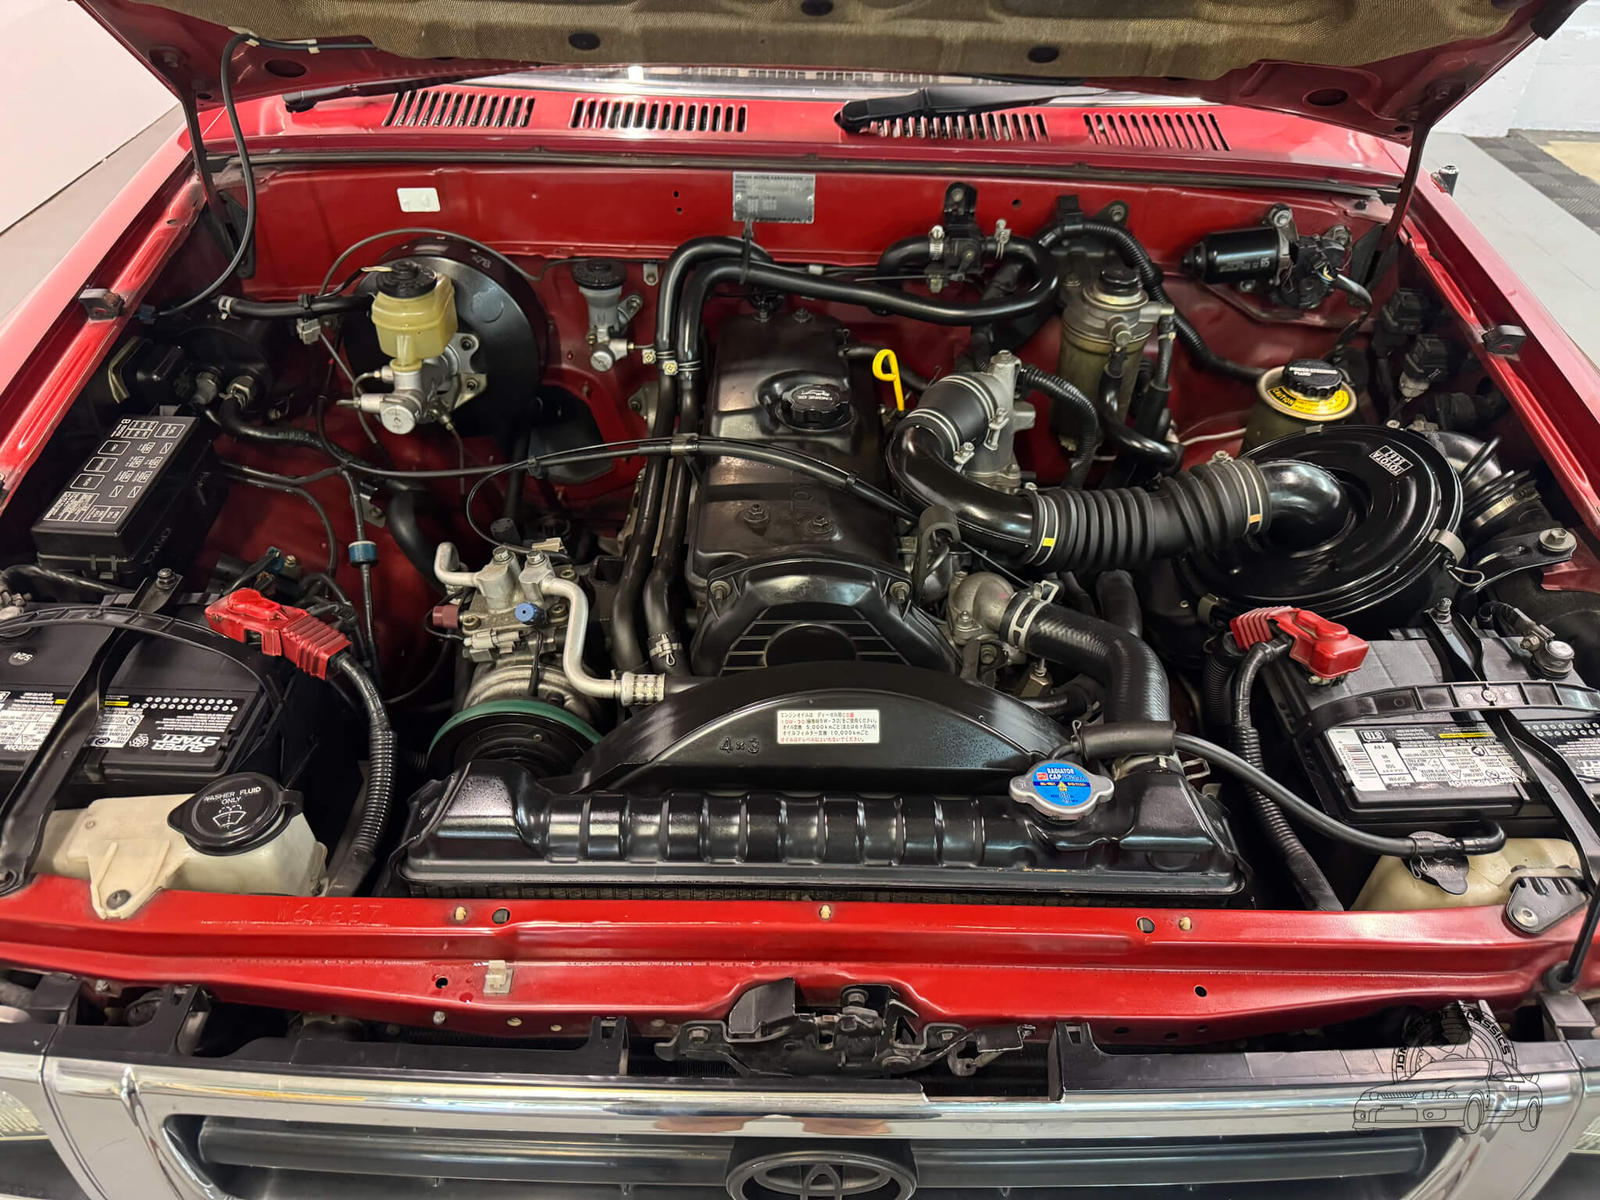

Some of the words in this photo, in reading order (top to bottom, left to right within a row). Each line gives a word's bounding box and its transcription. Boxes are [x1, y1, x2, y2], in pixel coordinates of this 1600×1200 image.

[1271, 387, 1295, 406] CAUTION
[1371, 451, 1403, 475] TOYOTA
[152, 733, 221, 746] START
[151, 743, 207, 753] SUPER
[203, 791, 236, 802] WASHER
[239, 786, 262, 795] FLUID
[221, 796, 242, 805] ONLY
